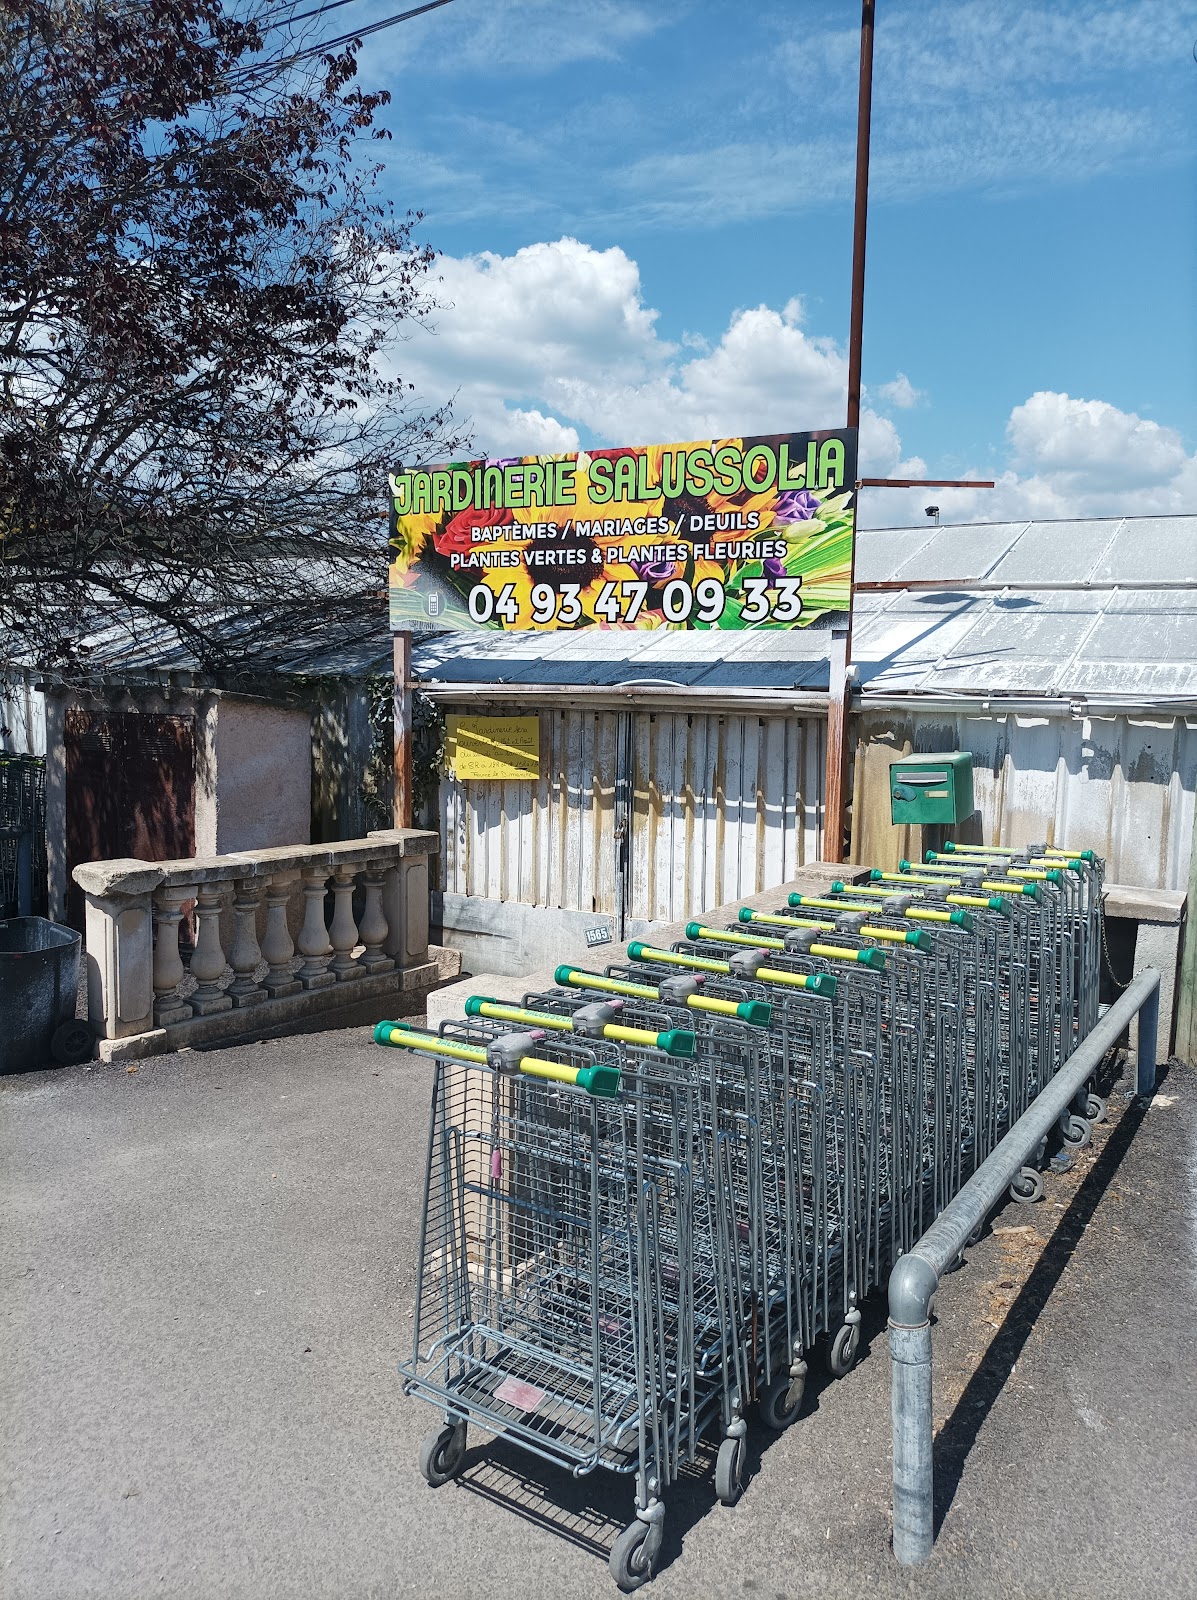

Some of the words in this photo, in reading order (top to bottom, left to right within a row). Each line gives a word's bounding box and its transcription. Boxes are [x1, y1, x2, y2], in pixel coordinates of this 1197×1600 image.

[393, 461, 576, 515] JARDINERIE
[588, 438, 846, 504] SALUSSOLIA
[471, 521, 557, 542] BAPTÈMES
[575, 516, 669, 538] MARIAGES
[689, 511, 760, 533] DEUILS
[450, 550, 521, 568] PLANTES
[523, 548, 587, 566] VERTES
[591, 547, 603, 565] &
[607, 544, 688, 564] PLANTES
[692, 540, 787, 561] FLEURIES
[467, 582, 519, 624] 04
[530, 581, 582, 624] 93
[594, 580, 649, 624] 47
[662, 578, 725, 623] 09
[740, 576, 804, 622] 33
[586, 927, 608, 942] 1565
